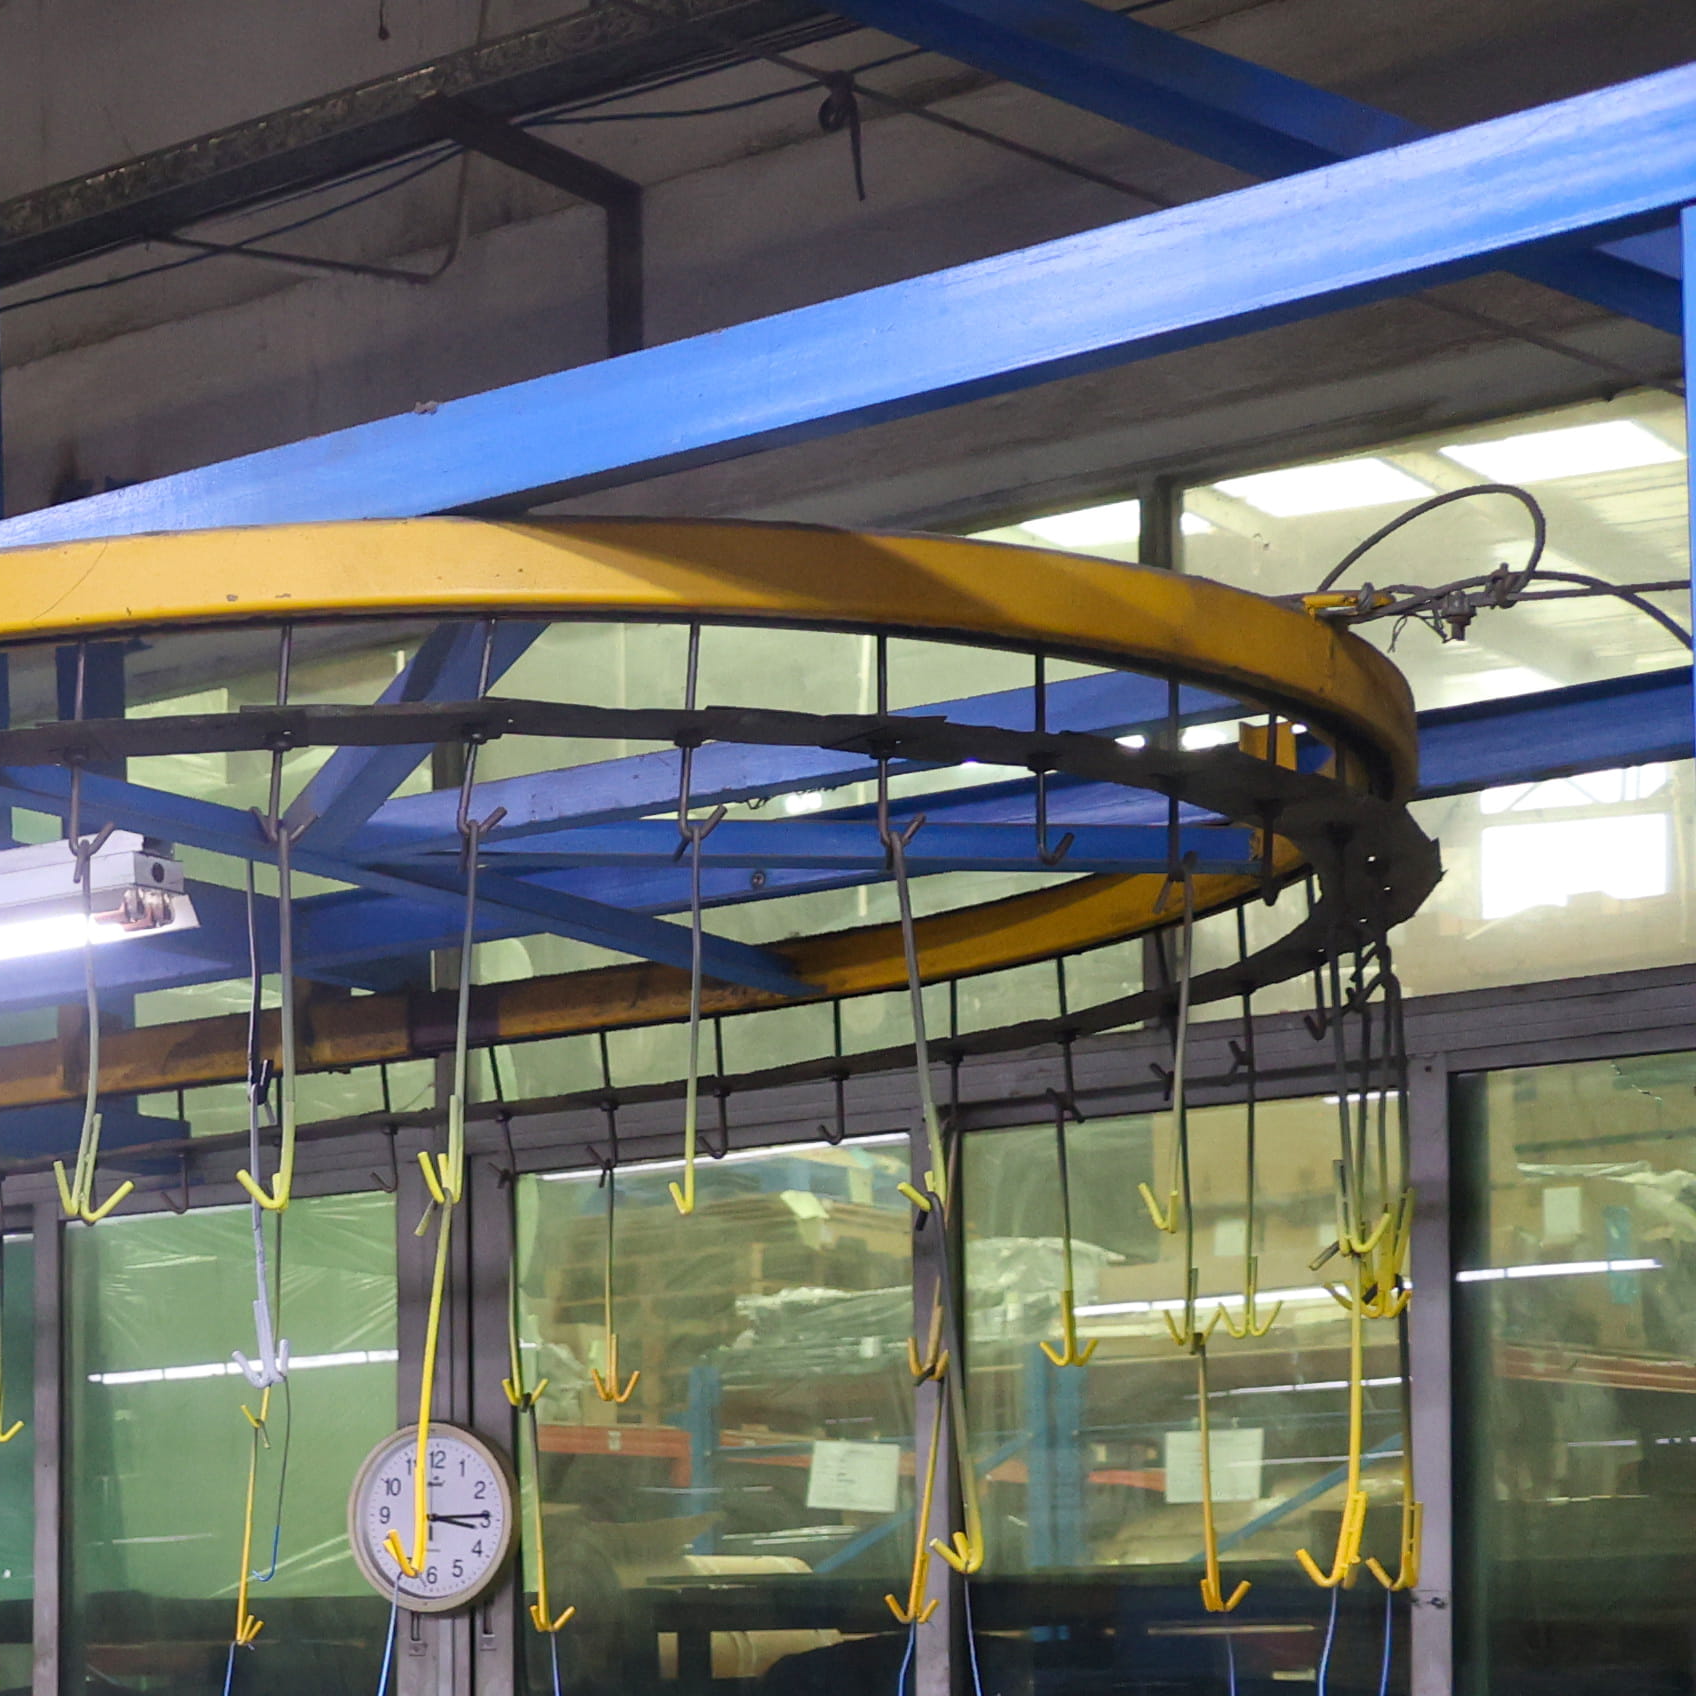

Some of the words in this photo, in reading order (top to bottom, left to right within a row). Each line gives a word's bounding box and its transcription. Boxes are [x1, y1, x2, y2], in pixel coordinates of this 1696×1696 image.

[429, 1450, 446, 1469] 12
[385, 1478, 402, 1496] 10
[474, 1480, 486, 1499] 2
[379, 1506, 391, 1524] 9
[480, 1509, 491, 1528] 3
[471, 1540, 483, 1557] 4
[426, 1566, 437, 1584] 6
[452, 1559, 463, 1578] 5
